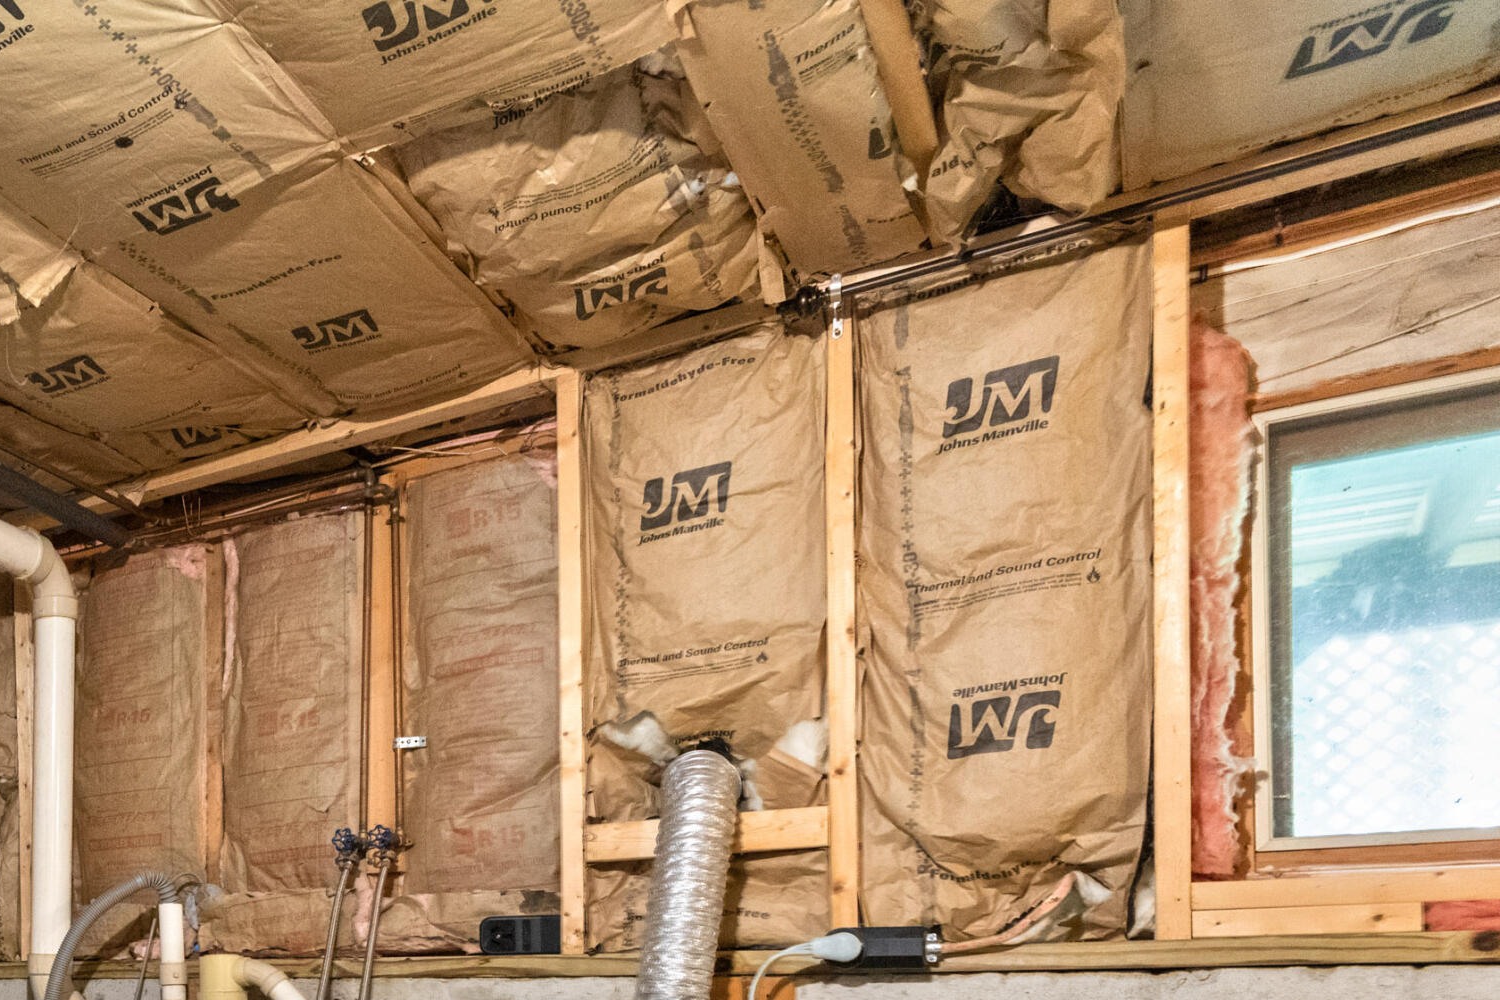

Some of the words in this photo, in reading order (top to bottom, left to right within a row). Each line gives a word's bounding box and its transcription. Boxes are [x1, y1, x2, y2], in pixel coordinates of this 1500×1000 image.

[380, 40, 426, 66] Johns
[427, 5, 497, 44] Manville
[794, 23, 856, 64] Therma
[1284, 0, 1454, 79] JM
[17, 145, 63, 167] Thermal
[65, 134, 86, 150] and
[87, 114, 127, 140] Sound
[127, 86, 174, 119] Control
[126, 182, 178, 209] Manville
[175, 164, 214, 189] Johns
[131, 176, 241, 236] JM
[541, 203, 582, 222] Sound
[585, 192, 611, 210] and
[494, 213, 540, 234] Control
[210, 253, 344, 302] Formaldehyde-Free
[626, 251, 666, 278] Johns
[291, 308, 379, 350] JM
[25, 354, 107, 394] JM
[942, 355, 1060, 439] JM
[936, 436, 980, 456] Johns
[981, 419, 1049, 443] Manville
[640, 460, 733, 532] JM
[636, 530, 671, 547] Johns
[672, 517, 725, 537] Manville
[911, 576, 966, 594] Thermal
[968, 569, 993, 585] and
[995, 559, 1043, 576] Sound
[1046, 548, 1102, 568] Control
[662, 650, 683, 662] and
[685, 644, 722, 658] Sound
[723, 636, 769, 652] Control
[953, 679, 1018, 699] Manville
[1020, 672, 1068, 687] Johns
[946, 690, 1061, 760] JM
